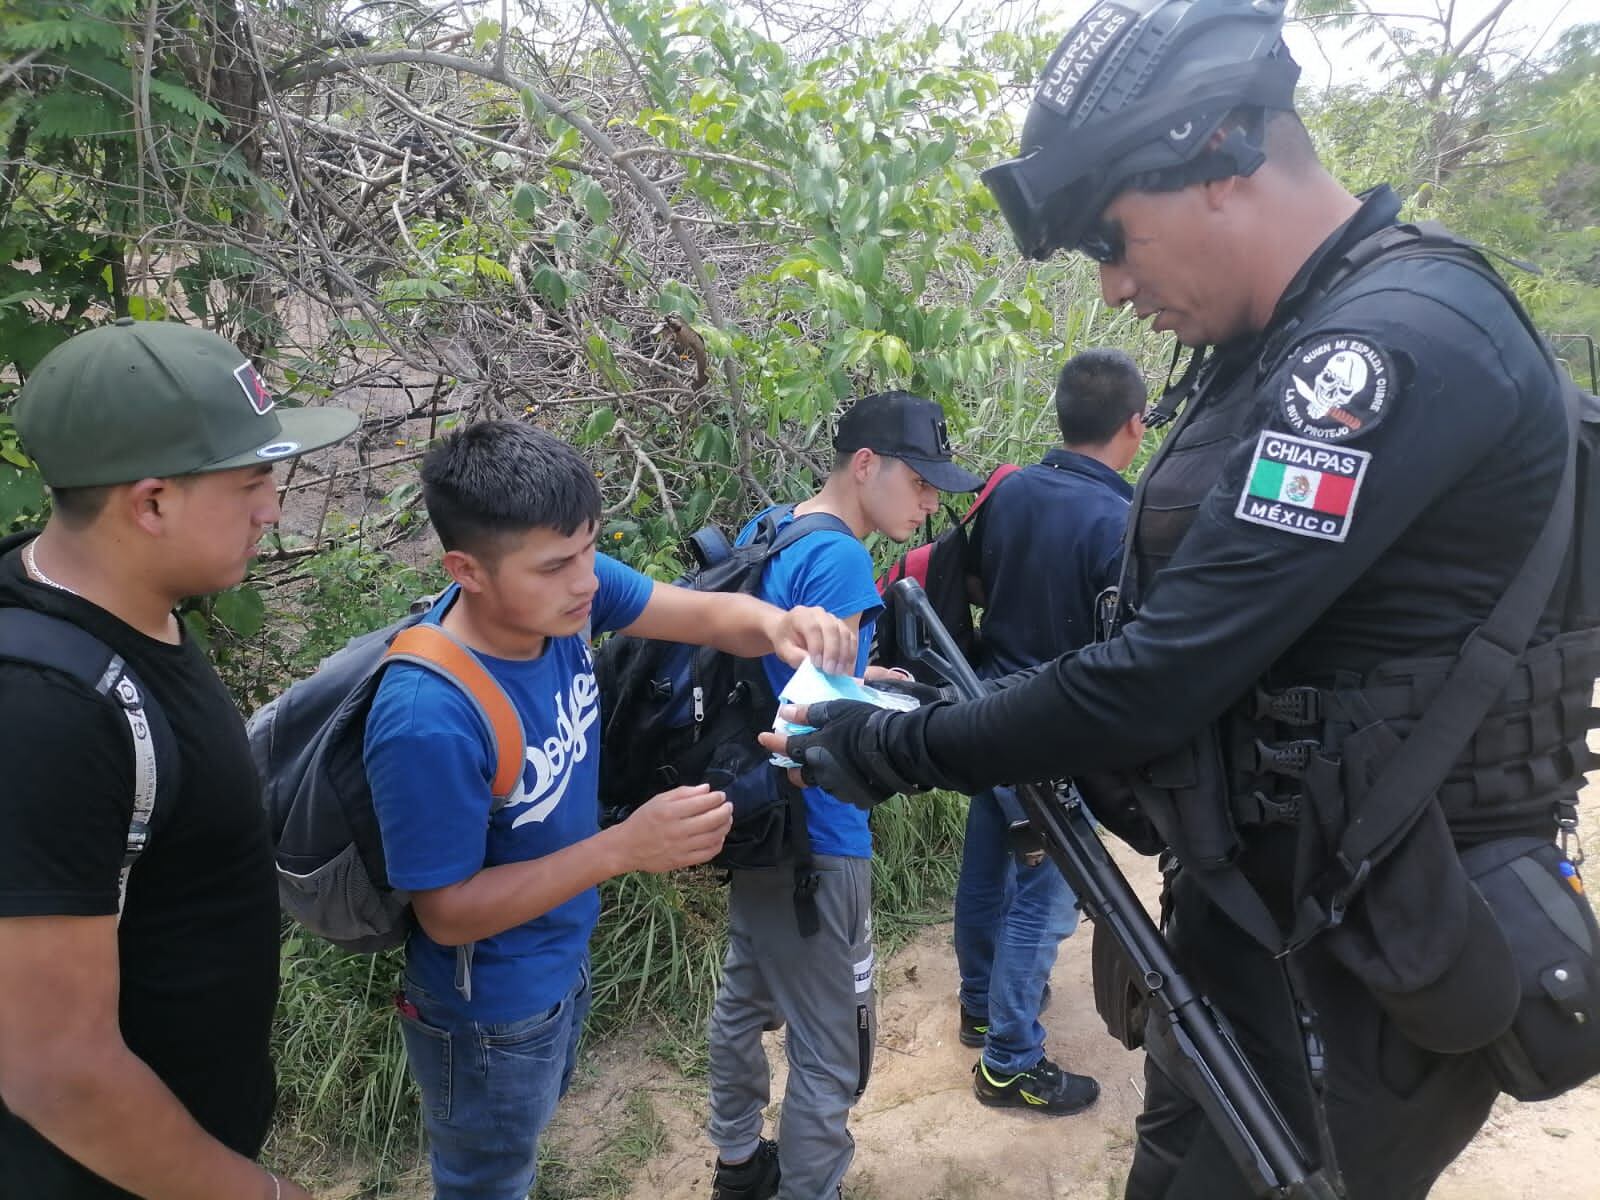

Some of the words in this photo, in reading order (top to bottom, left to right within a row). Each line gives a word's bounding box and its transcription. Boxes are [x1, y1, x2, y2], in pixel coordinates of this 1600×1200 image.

[1042, 6, 1116, 99] FUERZAS
[1055, 14, 1127, 106] ESTATALES
[1350, 341, 1385, 375] ESPALDA
[1369, 378, 1387, 412] CUBRE
[1266, 439, 1356, 474] CHIAPAS
[1303, 424, 1349, 438] PROTEJO
[1250, 502, 1337, 534] MÉXICO
